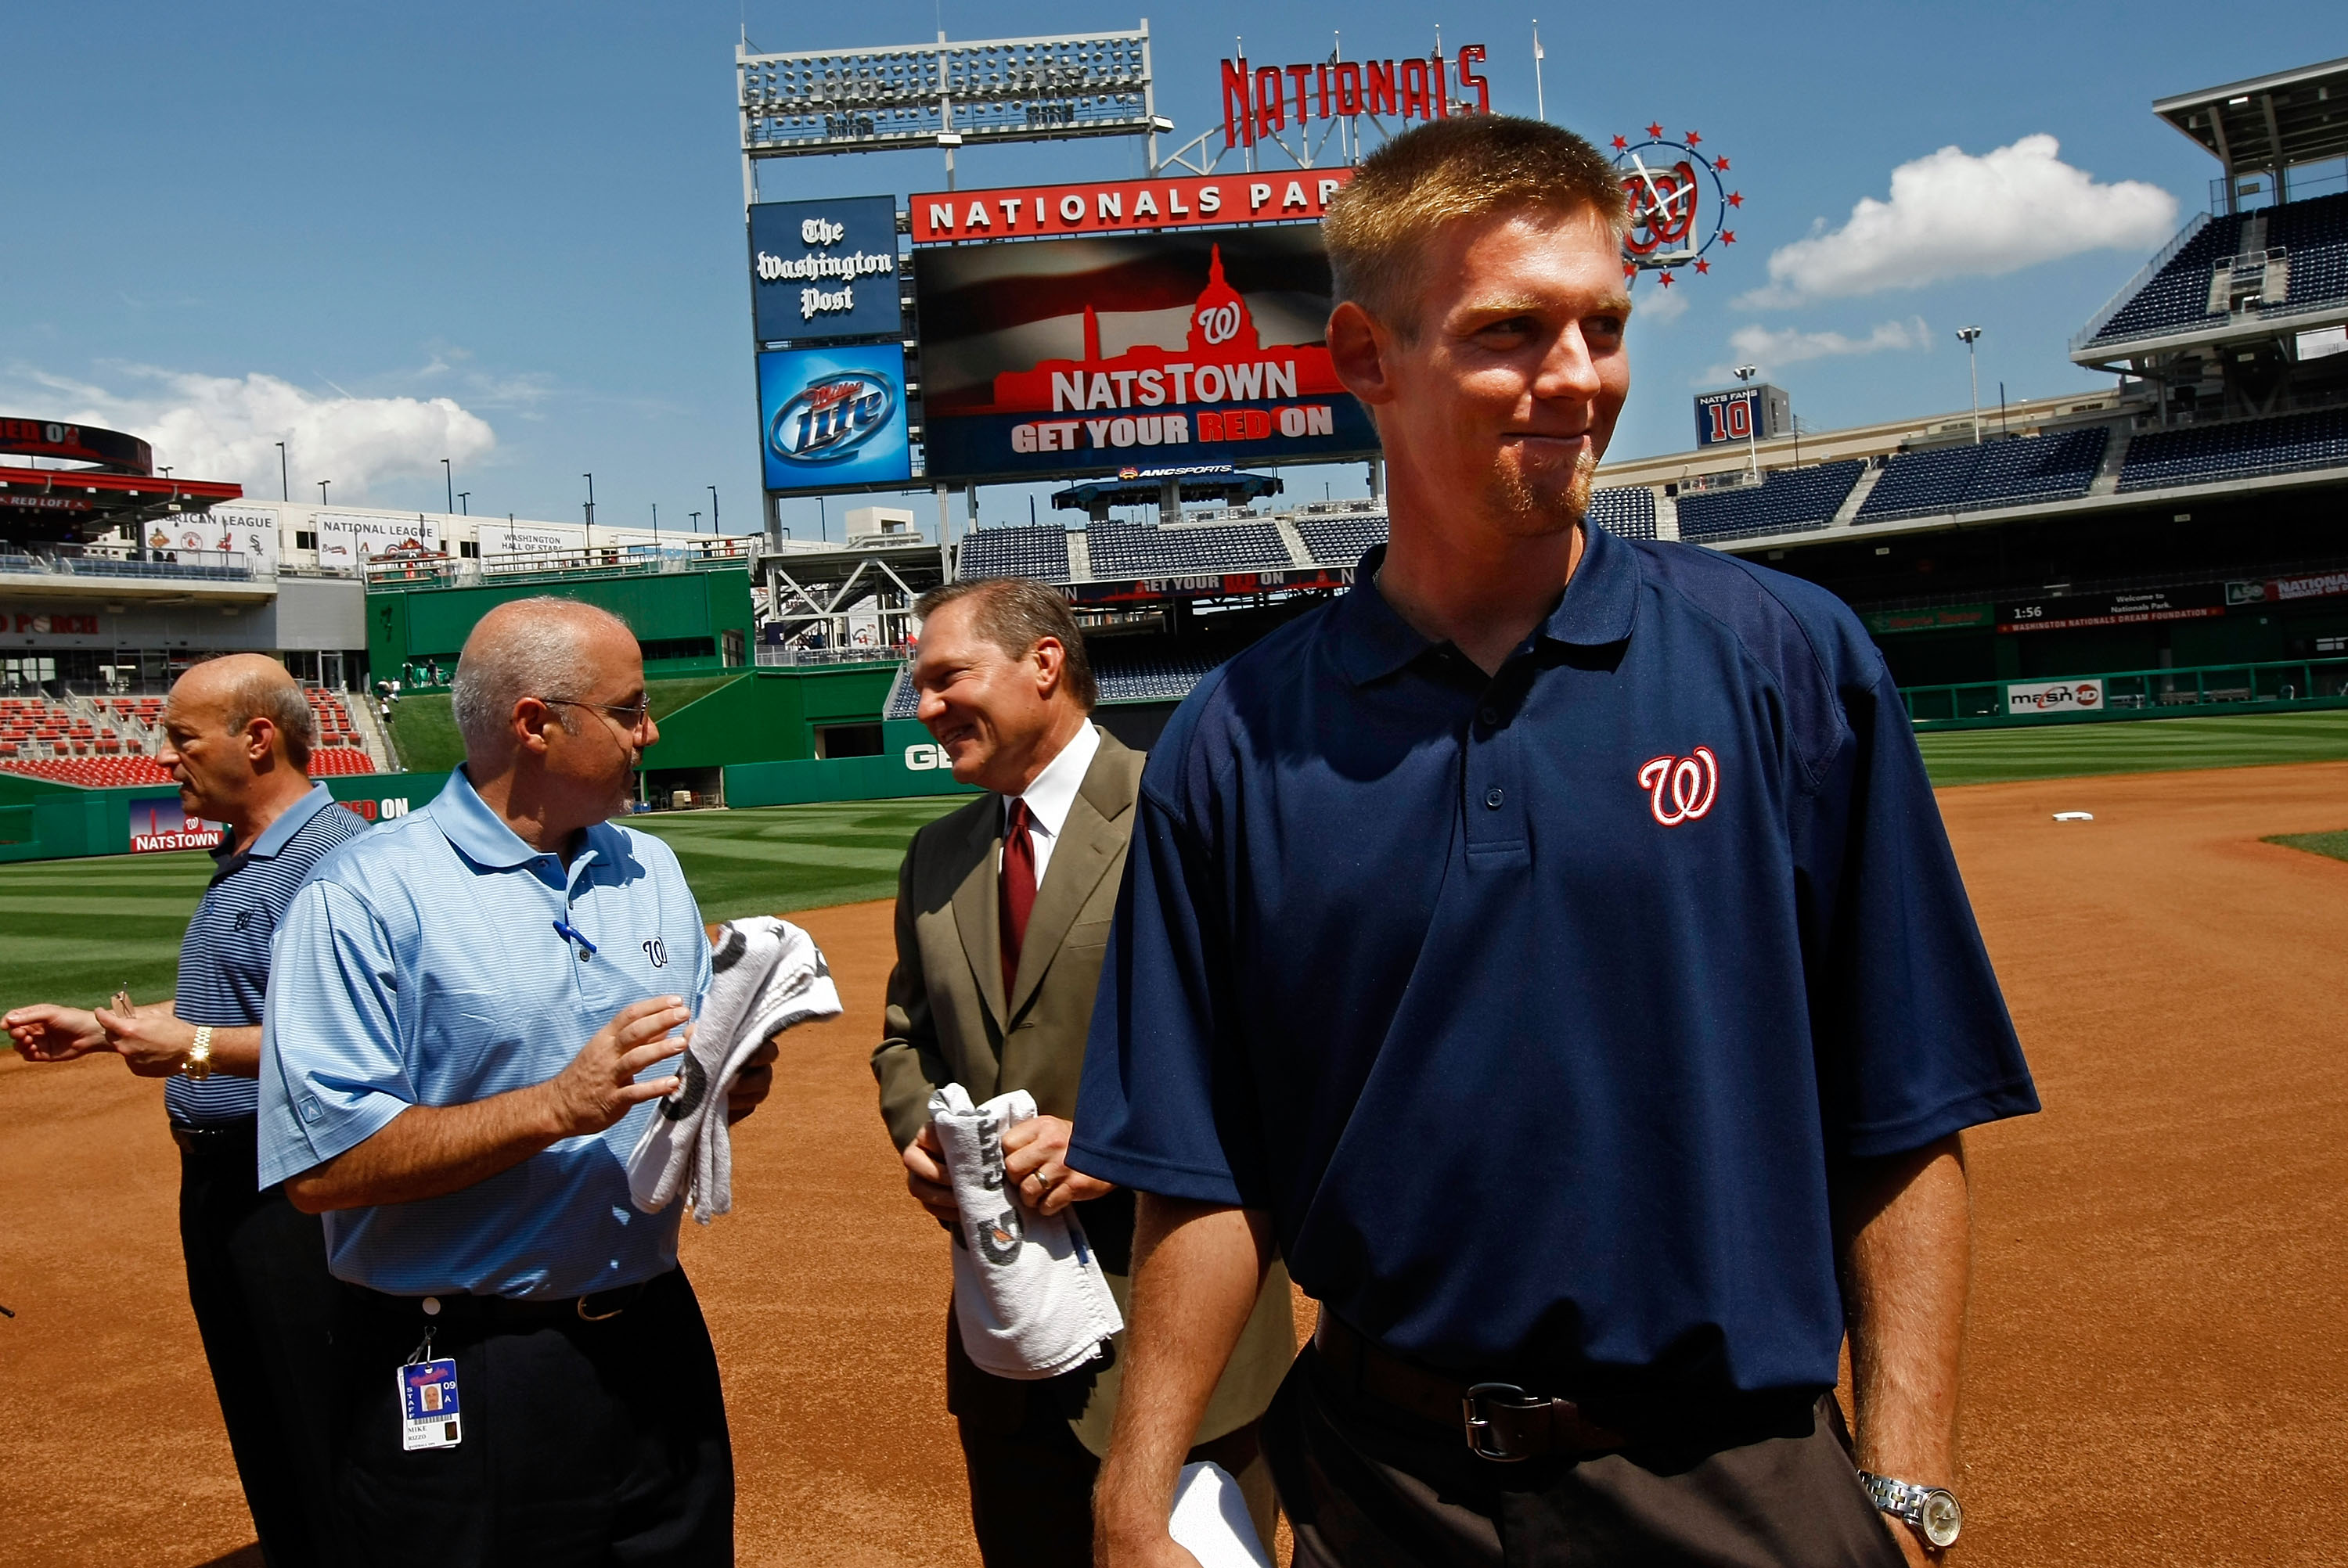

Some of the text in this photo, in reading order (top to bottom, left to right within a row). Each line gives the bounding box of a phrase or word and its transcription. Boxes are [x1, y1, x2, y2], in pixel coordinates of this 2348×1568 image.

[1221, 45, 1489, 148] NATIONALS
[930, 179, 1339, 228] NATIONALS PAR
[802, 218, 844, 246] The
[757, 250, 894, 281] Washington
[801, 286, 854, 319] Post
[1051, 361, 1298, 412] NATSTOWN
[1700, 390, 1758, 405] NATS FANS
[794, 391, 883, 455] Lite
[1011, 406, 1334, 454] GET YOUR RED ON
[1709, 400, 1751, 442] 10
[11, 497, 71, 508] RED LOFT
[323, 521, 387, 534] NATIONAL
[504, 534, 561, 545] WASHINGTON
[1173, 575, 1220, 590] YOUR
[1260, 572, 1285, 586] ON
[2278, 574, 2348, 594] NATIONA
[2111, 602, 2149, 613] Nationals
[2116, 595, 2154, 603] Welcome
[2011, 608, 2208, 631] WASHINGTON NATIONALS DREAM FOUNDATION
[2013, 606, 2044, 619] 1:56
[1637, 746, 1720, 827] W
[381, 797, 409, 819] ON
[136, 833, 219, 851] NATSTOWN
[642, 934, 668, 969] W
[443, 1381, 456, 1390] 09
[406, 1387, 416, 1419] STAFF
